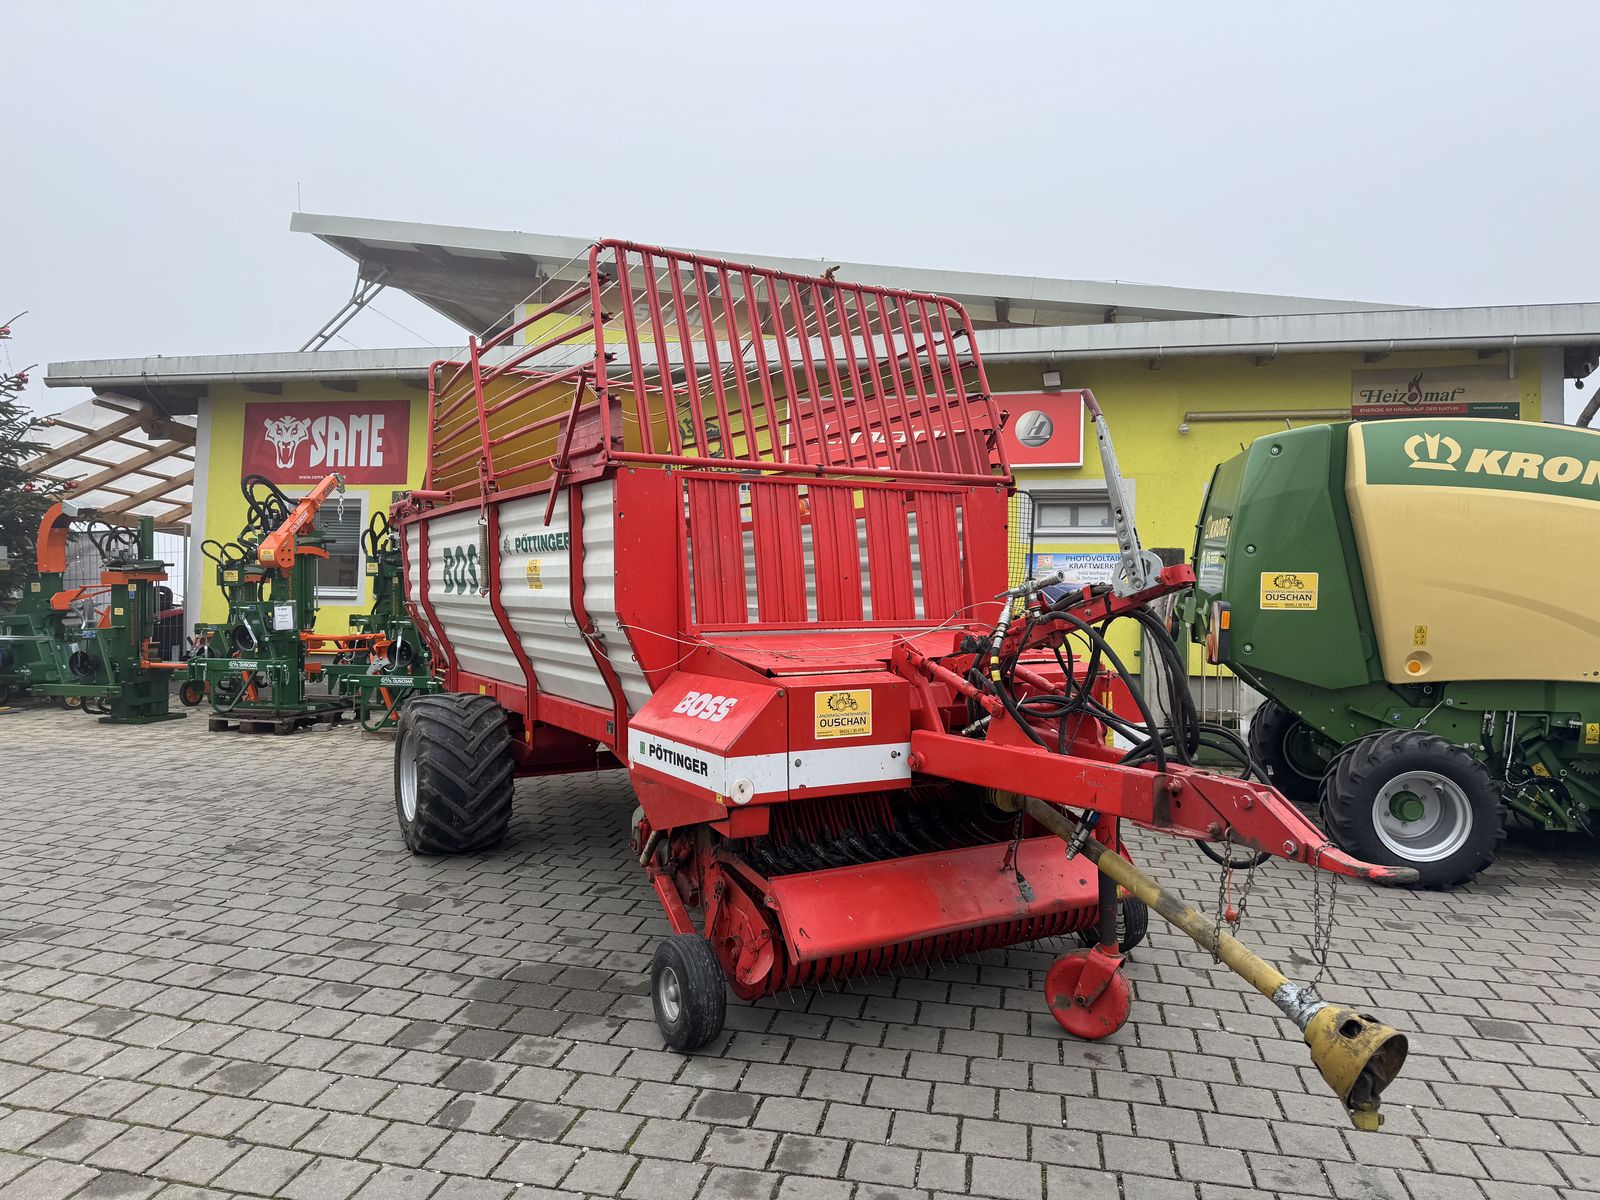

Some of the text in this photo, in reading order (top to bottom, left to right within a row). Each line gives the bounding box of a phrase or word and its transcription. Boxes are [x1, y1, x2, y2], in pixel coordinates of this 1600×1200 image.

[310, 414, 385, 468] SAME
[443, 543, 480, 595] BOS
[672, 691, 738, 722] BOSS
[820, 717, 867, 728] OUSCHAN
[649, 743, 708, 777] PÖTTINGER
